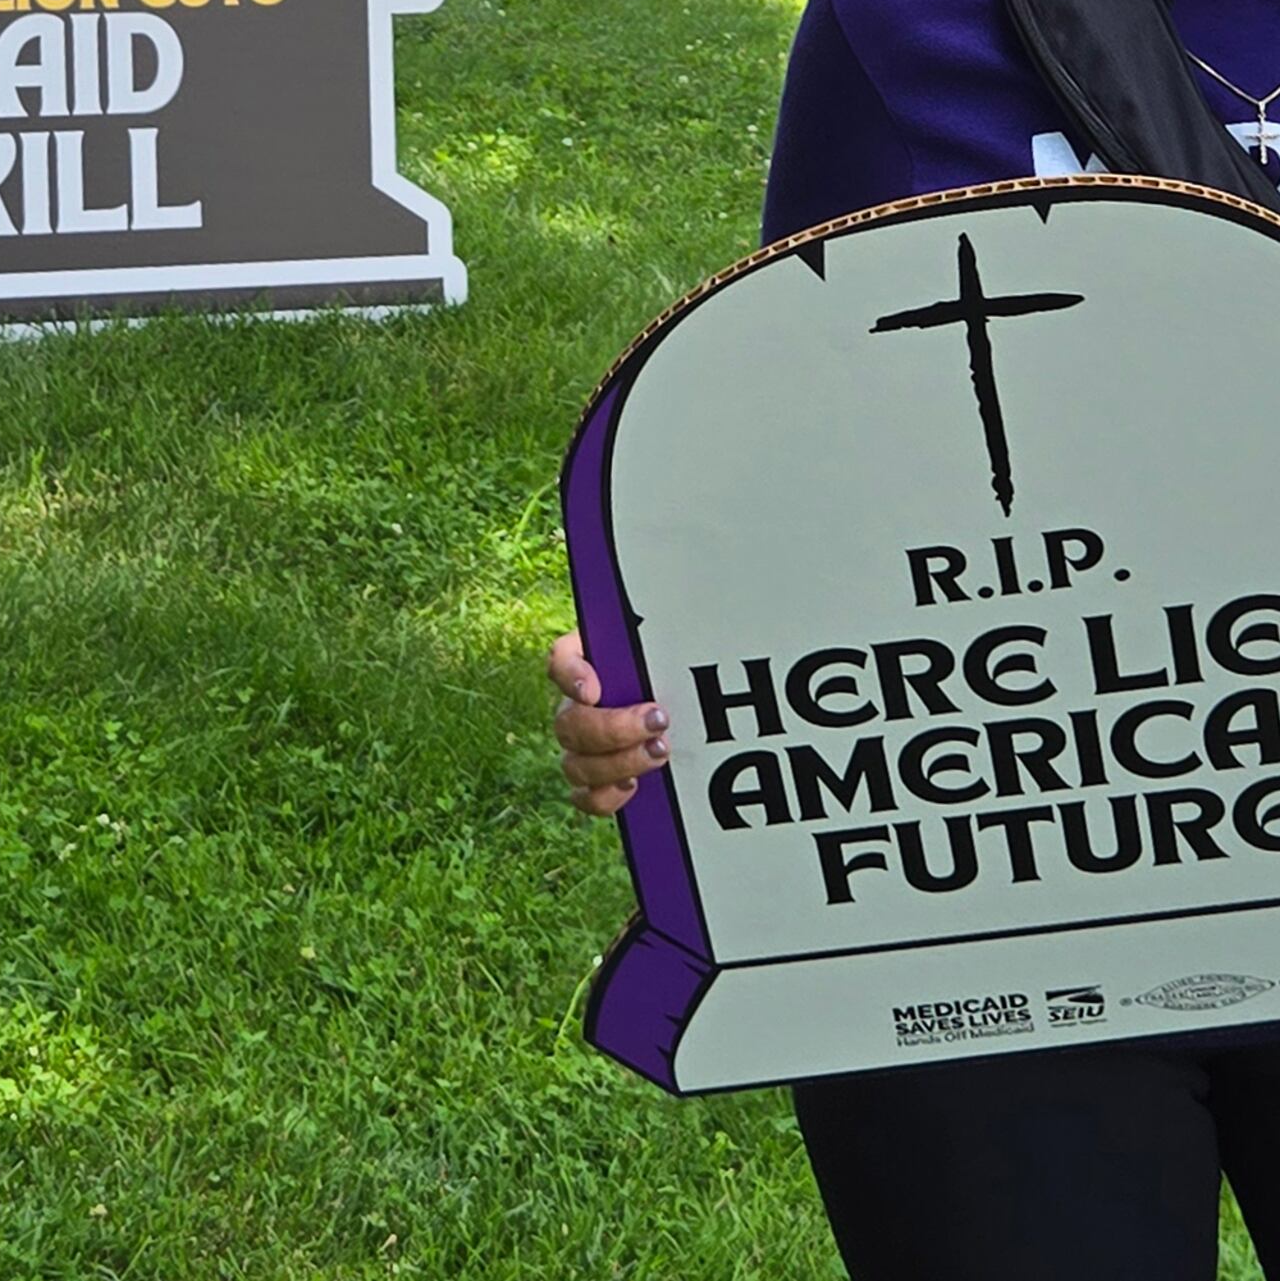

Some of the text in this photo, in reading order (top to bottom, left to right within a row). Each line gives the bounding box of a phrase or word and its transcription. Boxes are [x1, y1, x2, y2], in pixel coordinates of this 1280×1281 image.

[906, 528, 1131, 607] R.I.P.
[689, 626, 1058, 744] HERE
[892, 993, 1029, 1023] MEDICAID
[896, 1015, 965, 1036] SAVES
[970, 1008, 1032, 1028] LIVES
[1048, 1004, 1105, 1023] SEIU
[897, 1033, 942, 1047] Hands
[945, 1030, 968, 1043] Off
[970, 1021, 1035, 1040] Medicaid
